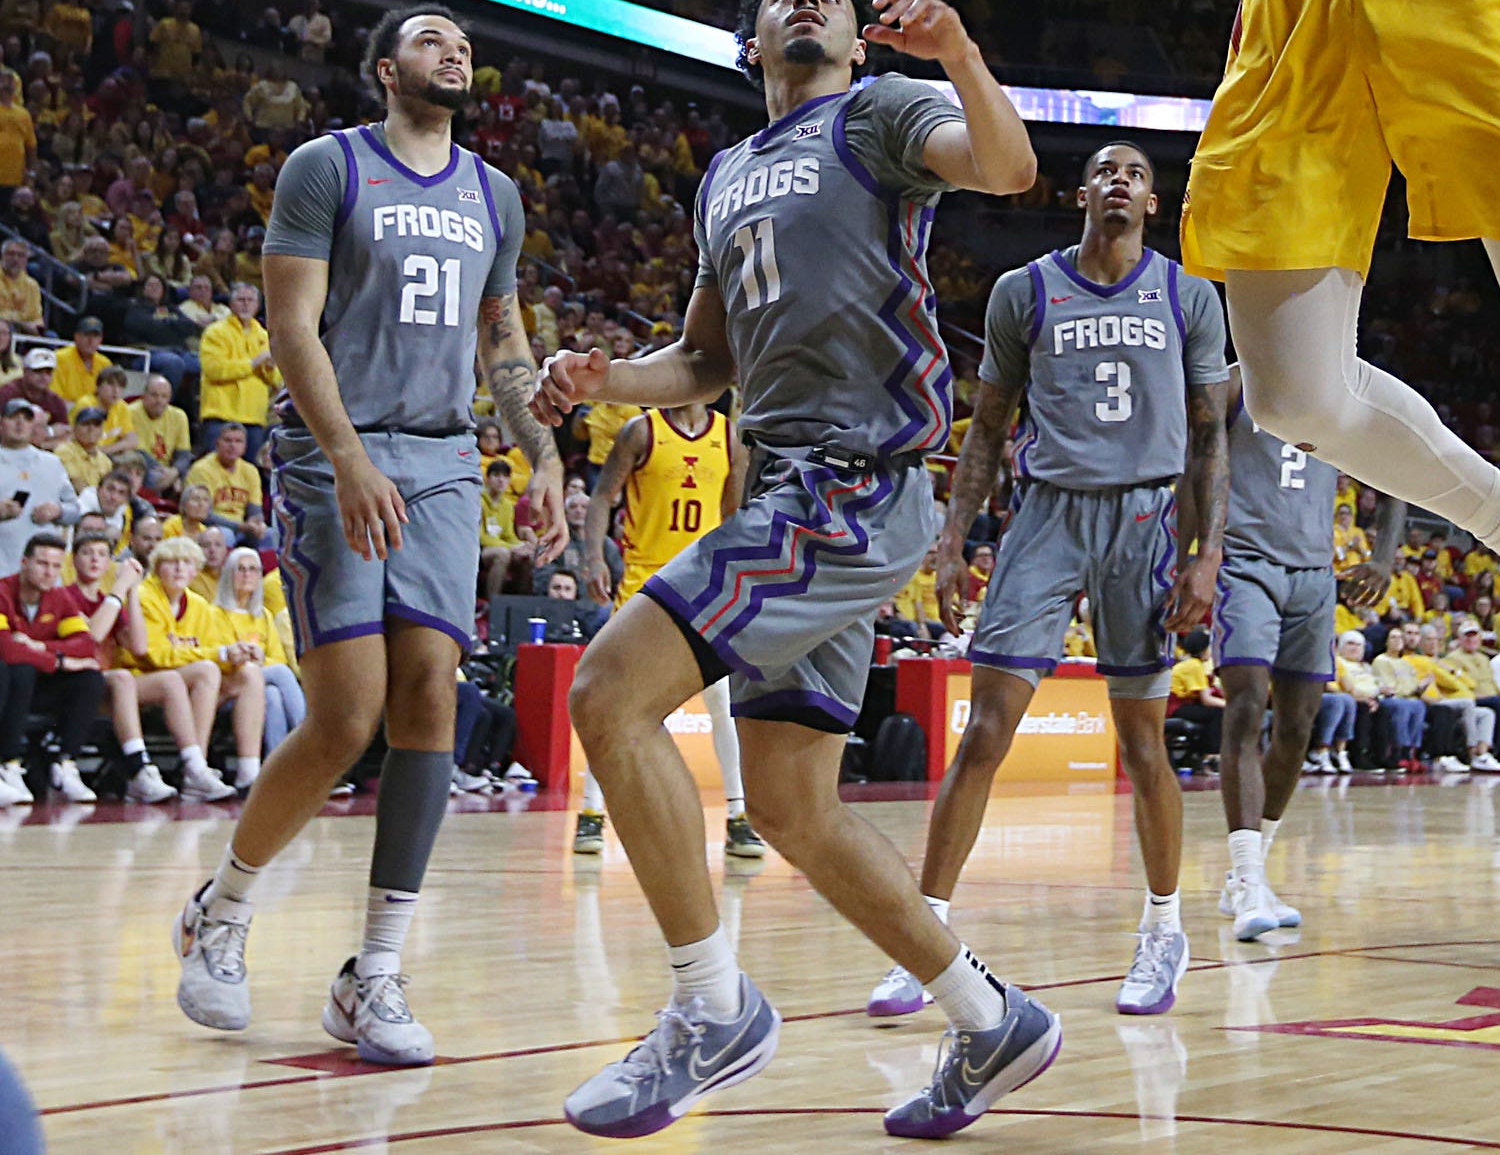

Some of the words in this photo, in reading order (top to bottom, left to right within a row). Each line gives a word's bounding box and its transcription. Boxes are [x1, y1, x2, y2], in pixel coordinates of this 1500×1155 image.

[373, 204, 484, 252] FROGS
[708, 157, 820, 241] FROGS
[400, 254, 461, 327] 21
[733, 217, 781, 310] 11
[1053, 315, 1166, 355] FROGS
[1094, 361, 1132, 422] 3
[669, 498, 702, 533] 10
